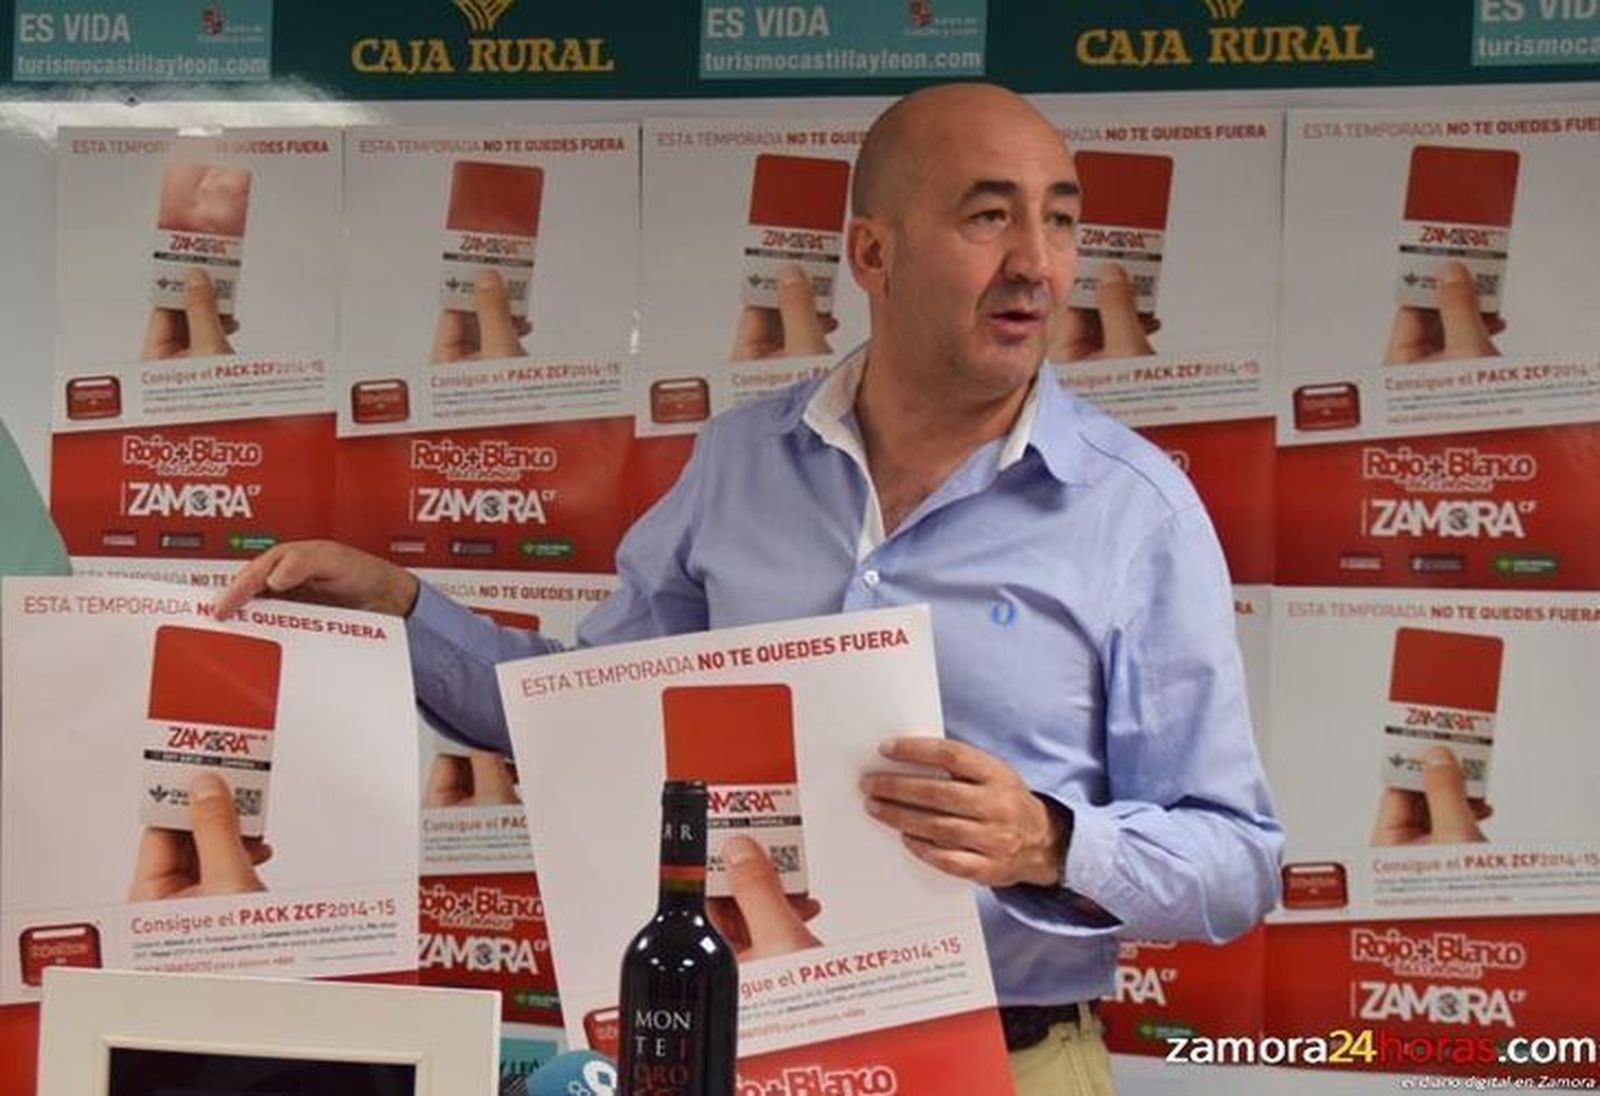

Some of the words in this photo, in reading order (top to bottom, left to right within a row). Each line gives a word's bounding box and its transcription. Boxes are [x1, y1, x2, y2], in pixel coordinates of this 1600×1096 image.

[706, 8, 744, 38] ES
[756, 6, 830, 37] VIDA
[1540, 0, 1600, 19] VID
[20, 14, 54, 43] ES
[64, 14, 130, 43] VIDA
[351, 38, 455, 74] CAJA
[468, 37, 615, 72] RURAL
[1076, 28, 1193, 68] CAJA
[1208, 25, 1374, 63] RURAL
[787, 132, 808, 145] NO
[811, 131, 827, 145] TE
[1106, 129, 1127, 142] NO
[1130, 128, 1148, 142] TE
[1152, 126, 1212, 141] QUEDES
[1215, 124, 1266, 139] FUERA
[1446, 122, 1469, 136] NO
[1472, 121, 1492, 136] TE
[1496, 119, 1562, 135] QUEDES
[484, 140, 504, 152] NO
[525, 138, 578, 152] QUEDES
[582, 137, 624, 151] FUERA
[1477, 368, 1519, 384] PACK
[127, 481, 253, 518] ZAMORA
[417, 487, 547, 524] ZAMORA
[1370, 498, 1526, 539] ZAMORA
[479, 585, 499, 599] NO
[502, 585, 519, 599] TE
[24, 596, 71, 614] ESTA
[77, 596, 192, 616] TEMPORADA
[251, 611, 323, 633] QUEDES
[327, 621, 388, 640] FUERA
[1431, 605, 1454, 619] NO
[1457, 605, 1477, 620] TE
[1479, 606, 1543, 622] QUEDES
[521, 674, 571, 698] ESTA
[575, 655, 694, 688] TEMPORADA
[697, 651, 725, 671] NO
[729, 647, 753, 667] TE
[757, 637, 835, 663] QUEDES
[839, 628, 909, 653] FUERA
[1464, 852, 1505, 869] PACK
[131, 911, 213, 935] Consigue
[218, 910, 233, 928] el
[239, 905, 290, 925] PACK
[293, 899, 396, 921] ZCF2014-15
[778, 969, 796, 987] el
[799, 956, 852, 984] PACK
[1359, 981, 1516, 1028] ZAMORA
[634, 1009, 691, 1032] MON
